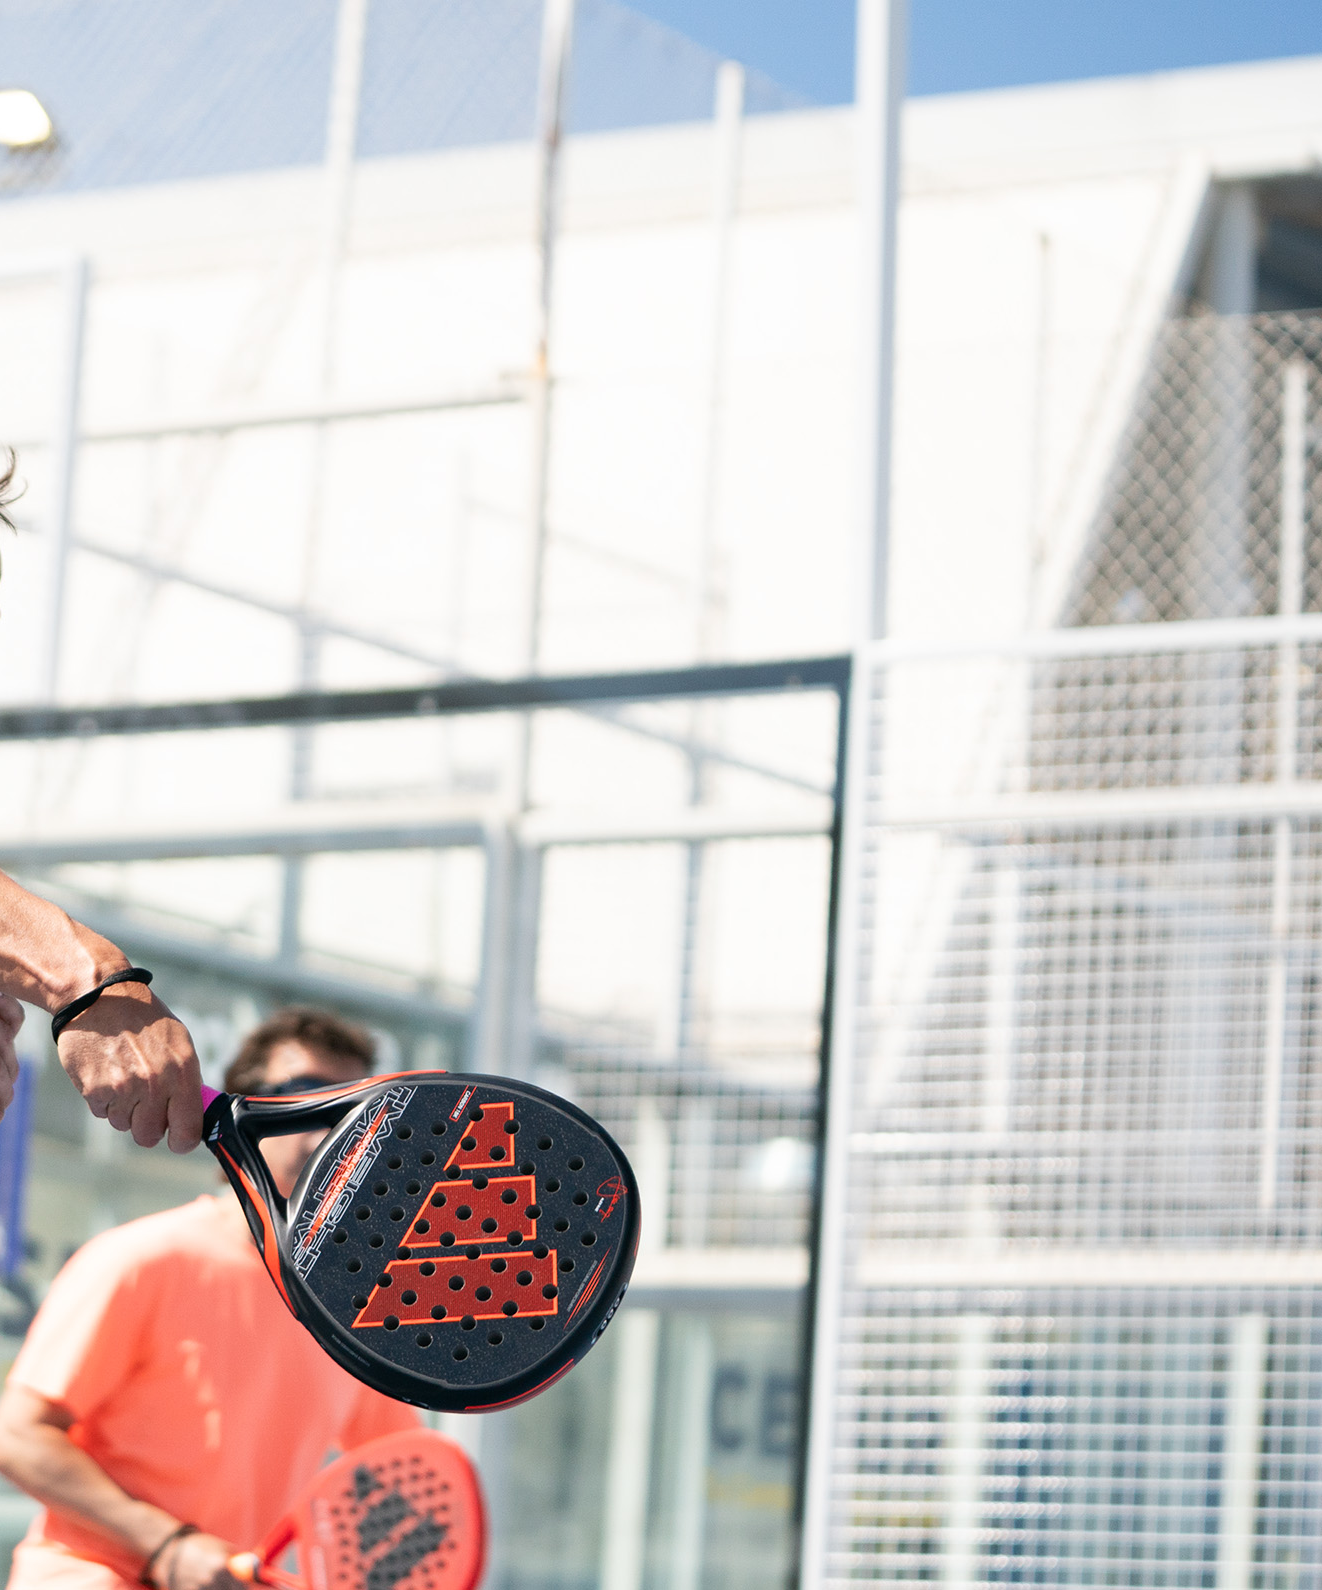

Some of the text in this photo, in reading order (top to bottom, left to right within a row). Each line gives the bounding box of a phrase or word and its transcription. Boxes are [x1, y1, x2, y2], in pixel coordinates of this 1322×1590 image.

[457, 1090, 471, 1109] CARBON
[318, 1131, 373, 1220] ADIPOWER CTRL MULTIWEIGHT
